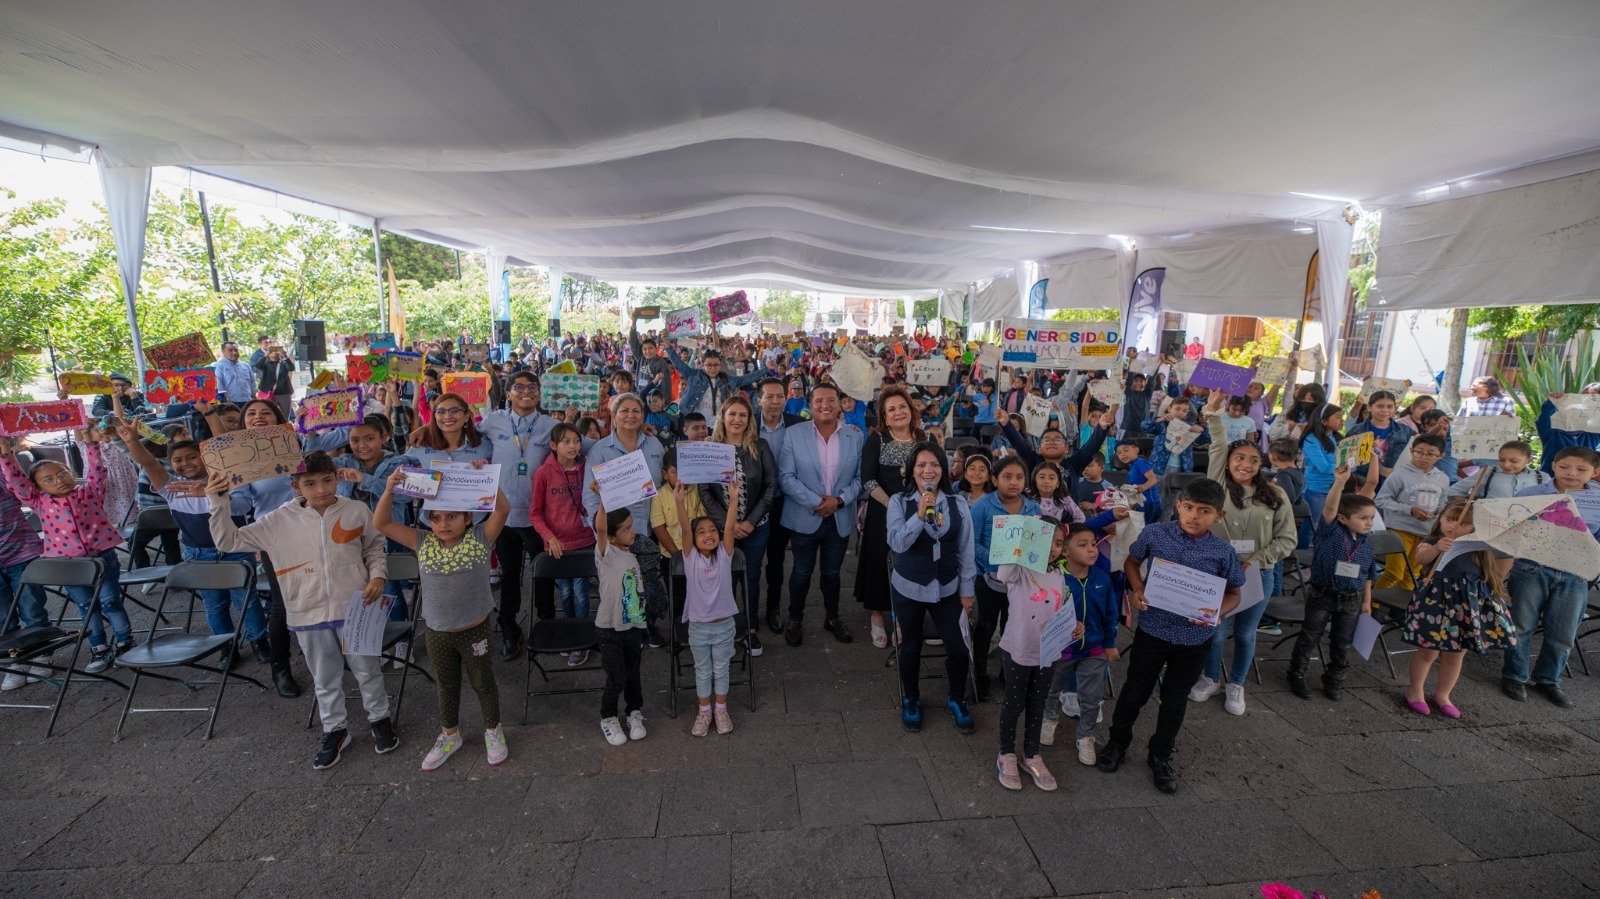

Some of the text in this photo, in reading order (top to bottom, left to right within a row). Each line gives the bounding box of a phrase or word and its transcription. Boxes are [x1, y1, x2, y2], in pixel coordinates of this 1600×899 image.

[1004, 327, 1118, 344] GENEROSIDAD
[679, 452, 731, 461] Reconocimiento
[441, 475, 494, 484] conocimiento
[599, 463, 644, 486] Reconocimiento
[1005, 526, 1037, 541] amor
[1152, 570, 1217, 596] Reconocimiento
